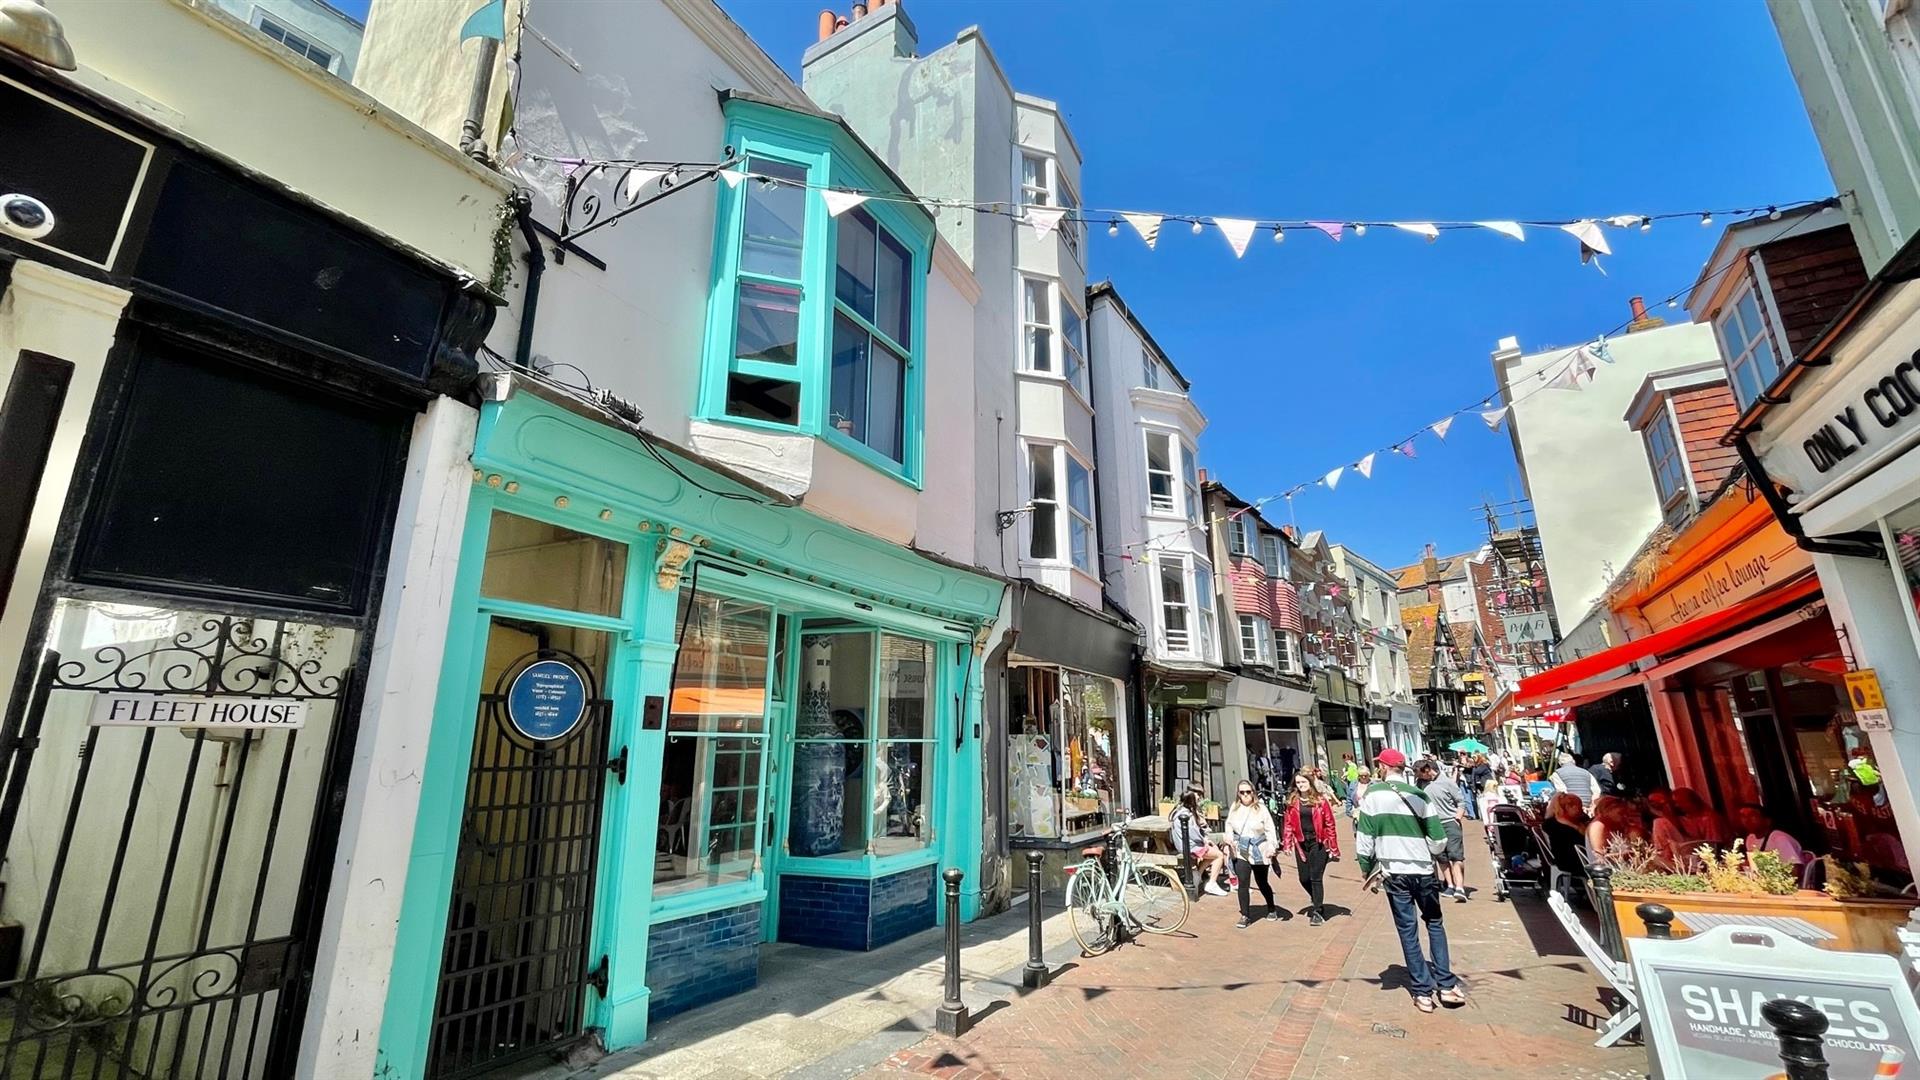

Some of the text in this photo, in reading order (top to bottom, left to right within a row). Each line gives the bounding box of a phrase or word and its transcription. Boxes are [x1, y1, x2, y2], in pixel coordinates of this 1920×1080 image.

[1803, 348, 1920, 473] ONLY COC
[1670, 555, 1770, 624] Aroma coffee lounge
[109, 699, 300, 724] FLEET HOUSE
